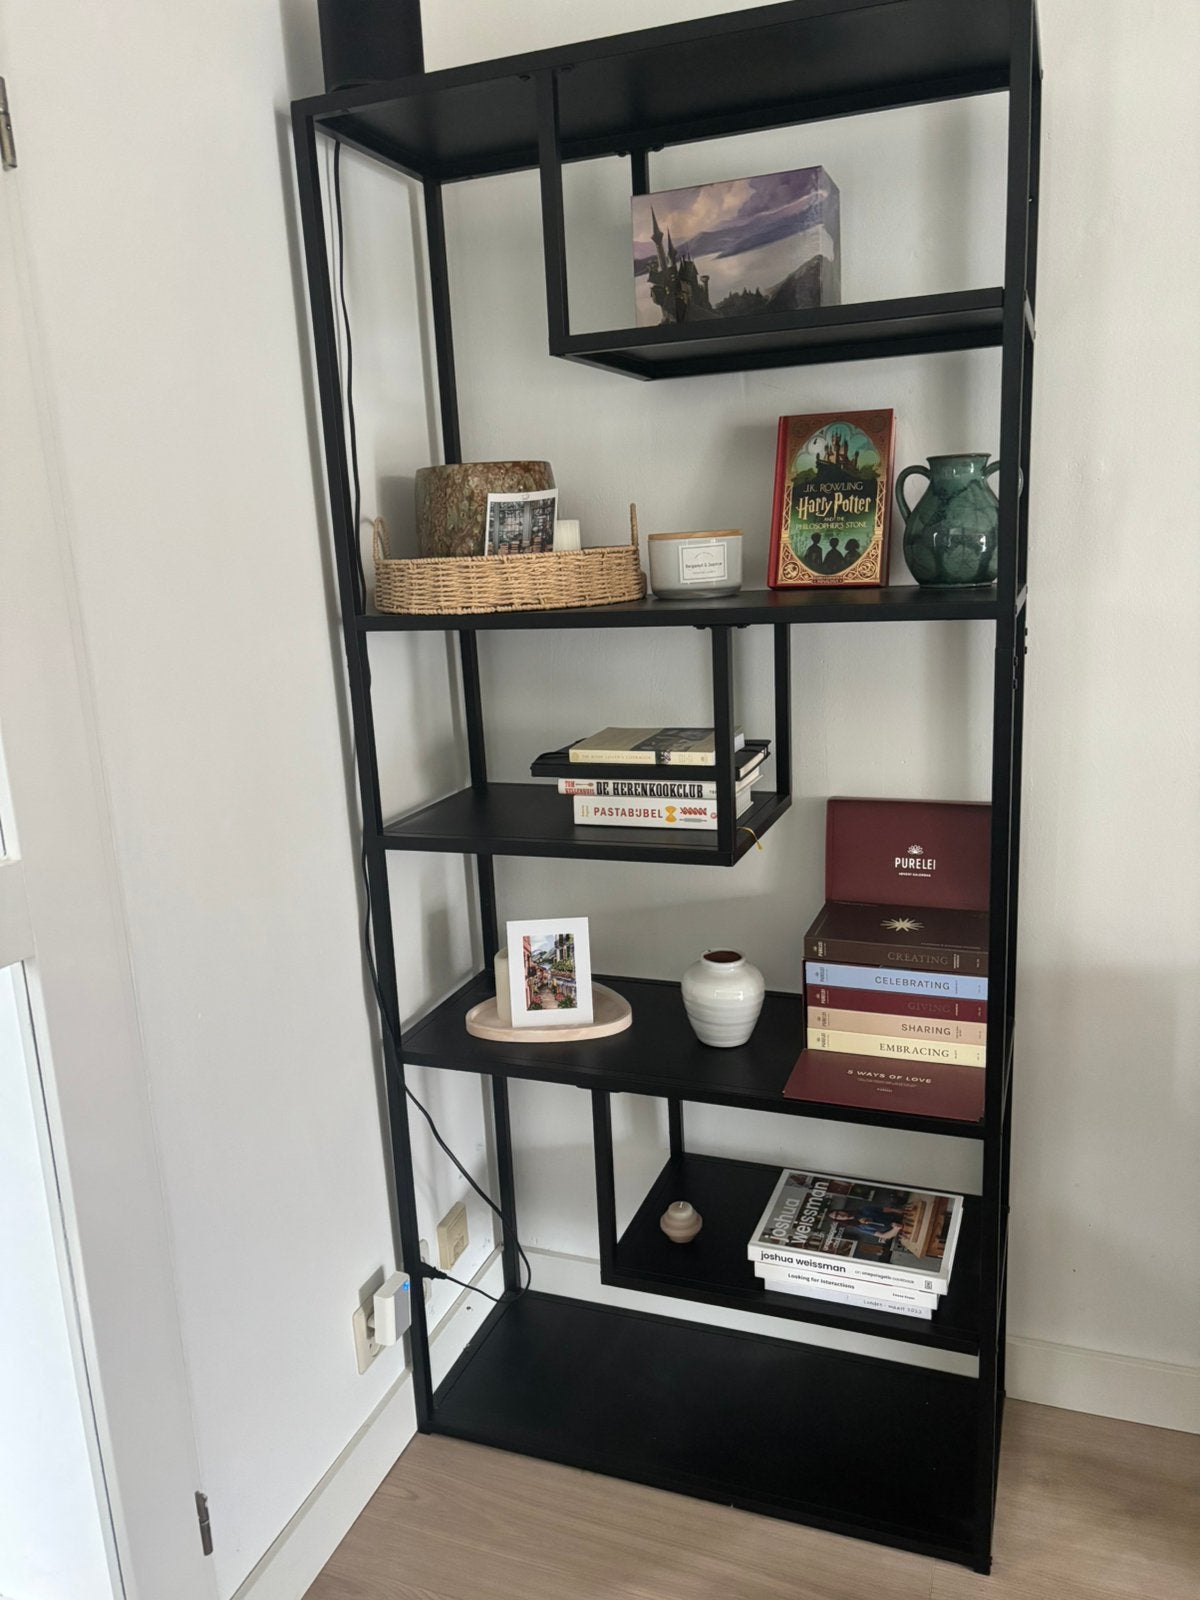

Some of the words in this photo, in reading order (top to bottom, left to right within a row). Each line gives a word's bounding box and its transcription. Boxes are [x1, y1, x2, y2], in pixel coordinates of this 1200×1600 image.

[820, 481, 864, 494] ROWLING
[796, 496, 833, 520] Harry
[834, 492, 872, 518] Potter
[846, 521, 867, 529] STONE
[596, 781, 609, 795] DE
[613, 781, 704, 798] HERENKOOKCLUB
[895, 857, 936, 870] PURELEI
[887, 951, 948, 966] CREATING
[874, 976, 950, 990] CELEBRATING
[907, 1002, 951, 1013] GIVING
[901, 1023, 951, 1036] SHARING
[879, 1043, 950, 1058] EMBRACING
[856, 1070, 885, 1078] WAYS
[906, 1076, 932, 1084] LOVE
[790, 1181, 830, 1244] weissman
[764, 1198, 801, 1243] joshua
[760, 1250, 794, 1264] joshua
[795, 1258, 846, 1273] weissman
[788, 1273, 810, 1282] Looking
